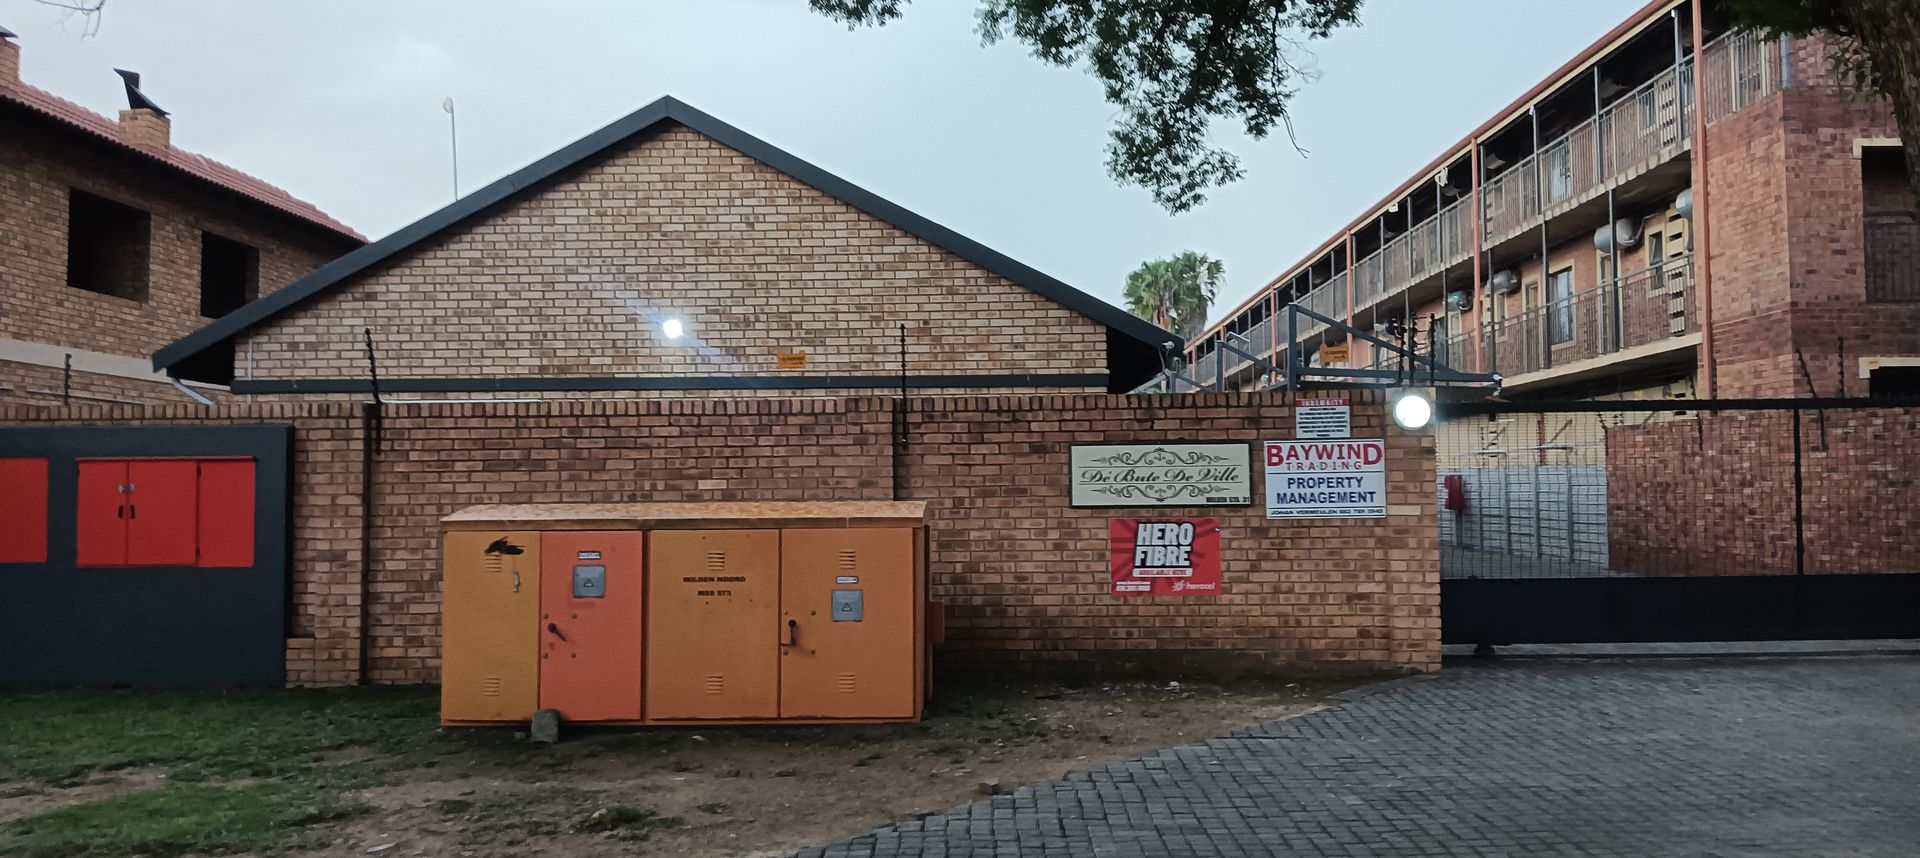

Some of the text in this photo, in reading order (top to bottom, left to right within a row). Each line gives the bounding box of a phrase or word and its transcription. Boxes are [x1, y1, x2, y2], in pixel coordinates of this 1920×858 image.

[1266, 443, 1383, 467] BAYWIND
[1114, 468, 1160, 483] Bute
[1163, 468, 1194, 482] De
[1196, 467, 1239, 482] Ville
[1287, 477, 1364, 489] PROPERTY
[1276, 491, 1377, 504] MANAGEMENT
[1136, 522, 1194, 546] HERO
[1134, 545, 1192, 567] FIBRE
